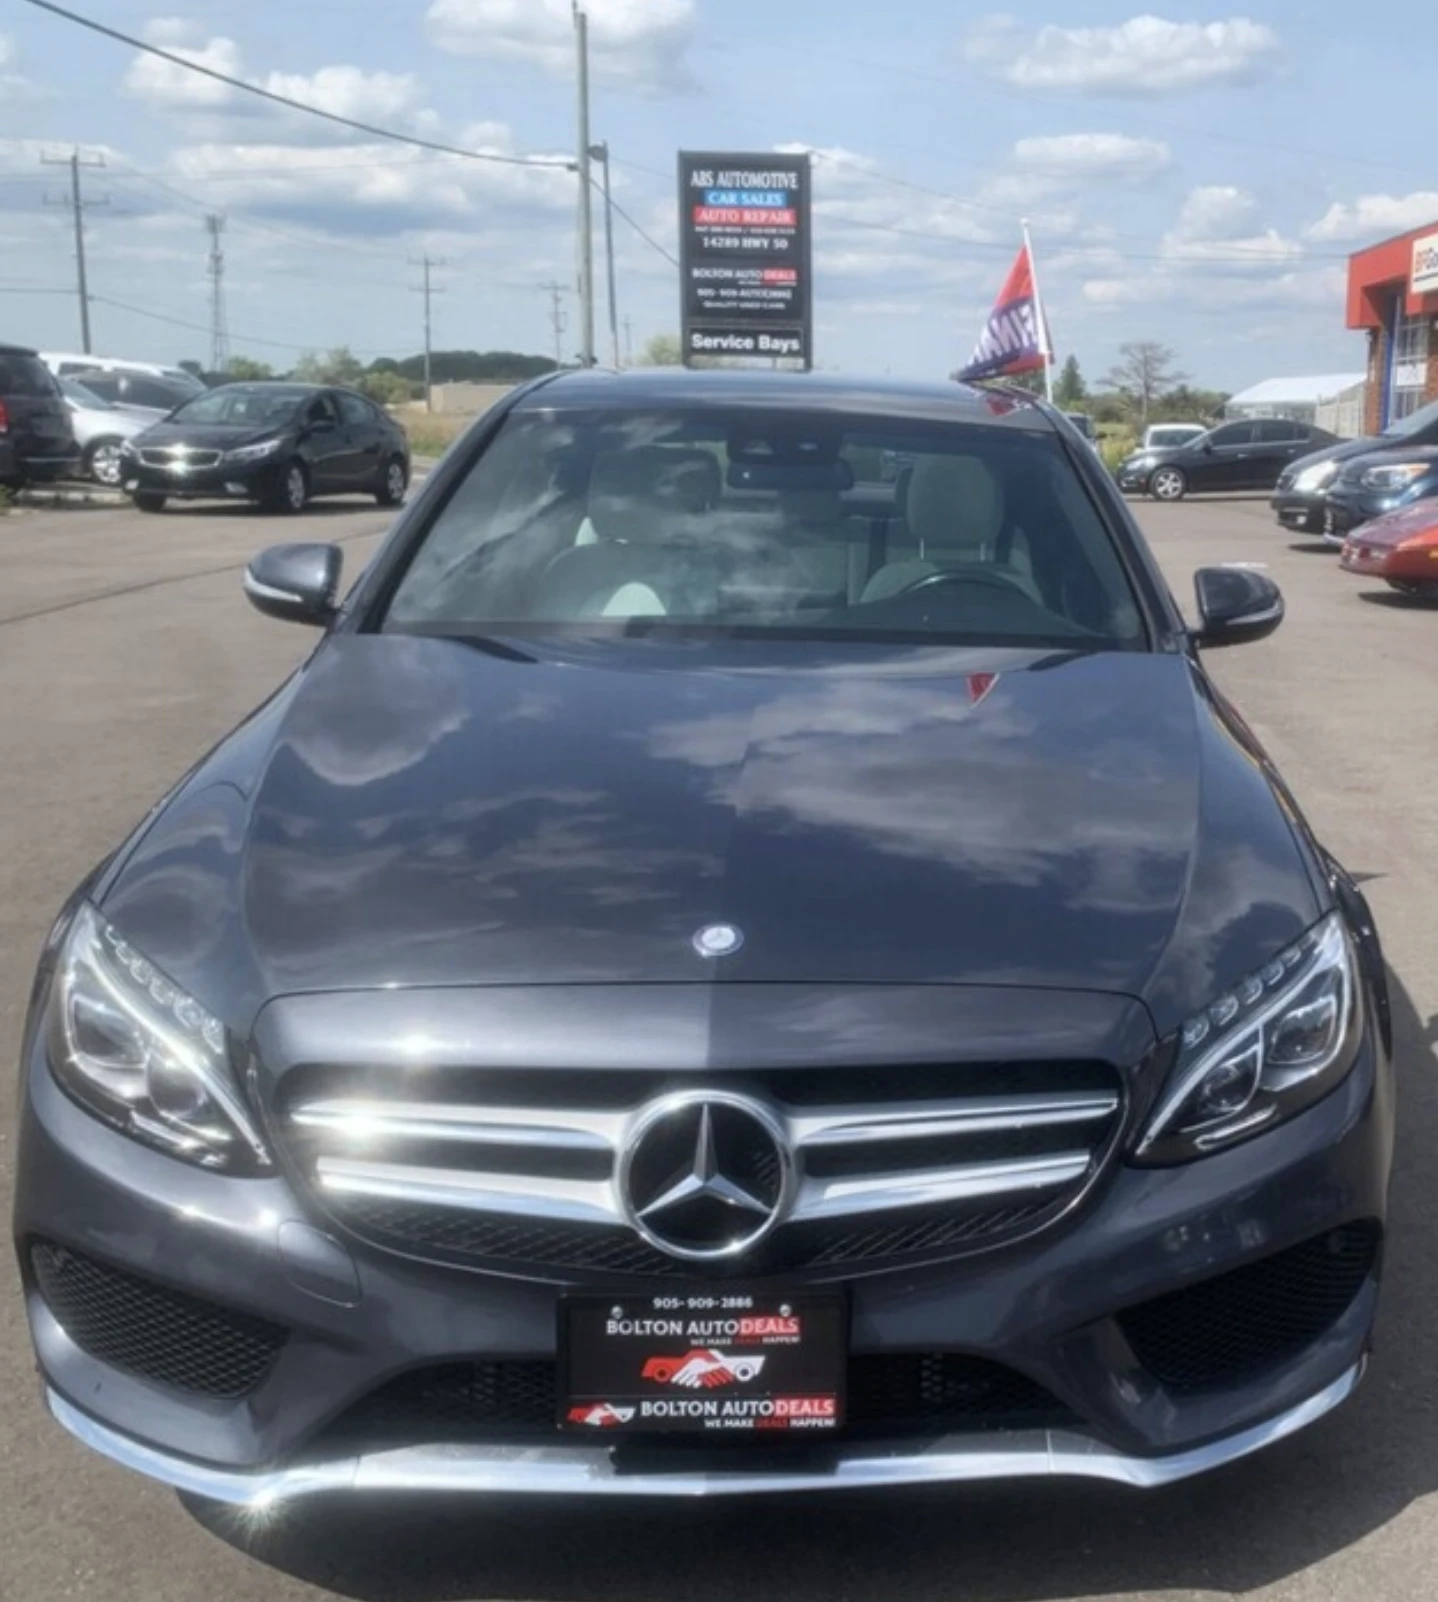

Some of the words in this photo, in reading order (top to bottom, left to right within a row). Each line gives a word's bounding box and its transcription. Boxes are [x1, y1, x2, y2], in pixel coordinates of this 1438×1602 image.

[691, 170, 714, 188] ABS
[716, 171, 799, 189] AUTOMOTIVE
[708, 191, 737, 205] CAR
[740, 192, 784, 206] SALES
[701, 209, 740, 223] AUTO
[743, 209, 793, 224] REPAIR
[703, 237, 740, 249] 14289
[741, 237, 769, 249] HWY
[773, 238, 789, 250] 50
[692, 268, 733, 279] BOLTON
[691, 333, 753, 350] Service
[758, 334, 800, 354] Bays
[606, 1318, 682, 1336] BOLTON
[706, 1338, 732, 1346] MAKE
[640, 1401, 717, 1417] BOLTON
[704, 1419, 721, 1429] WE
[723, 1419, 754, 1429] MAKE
